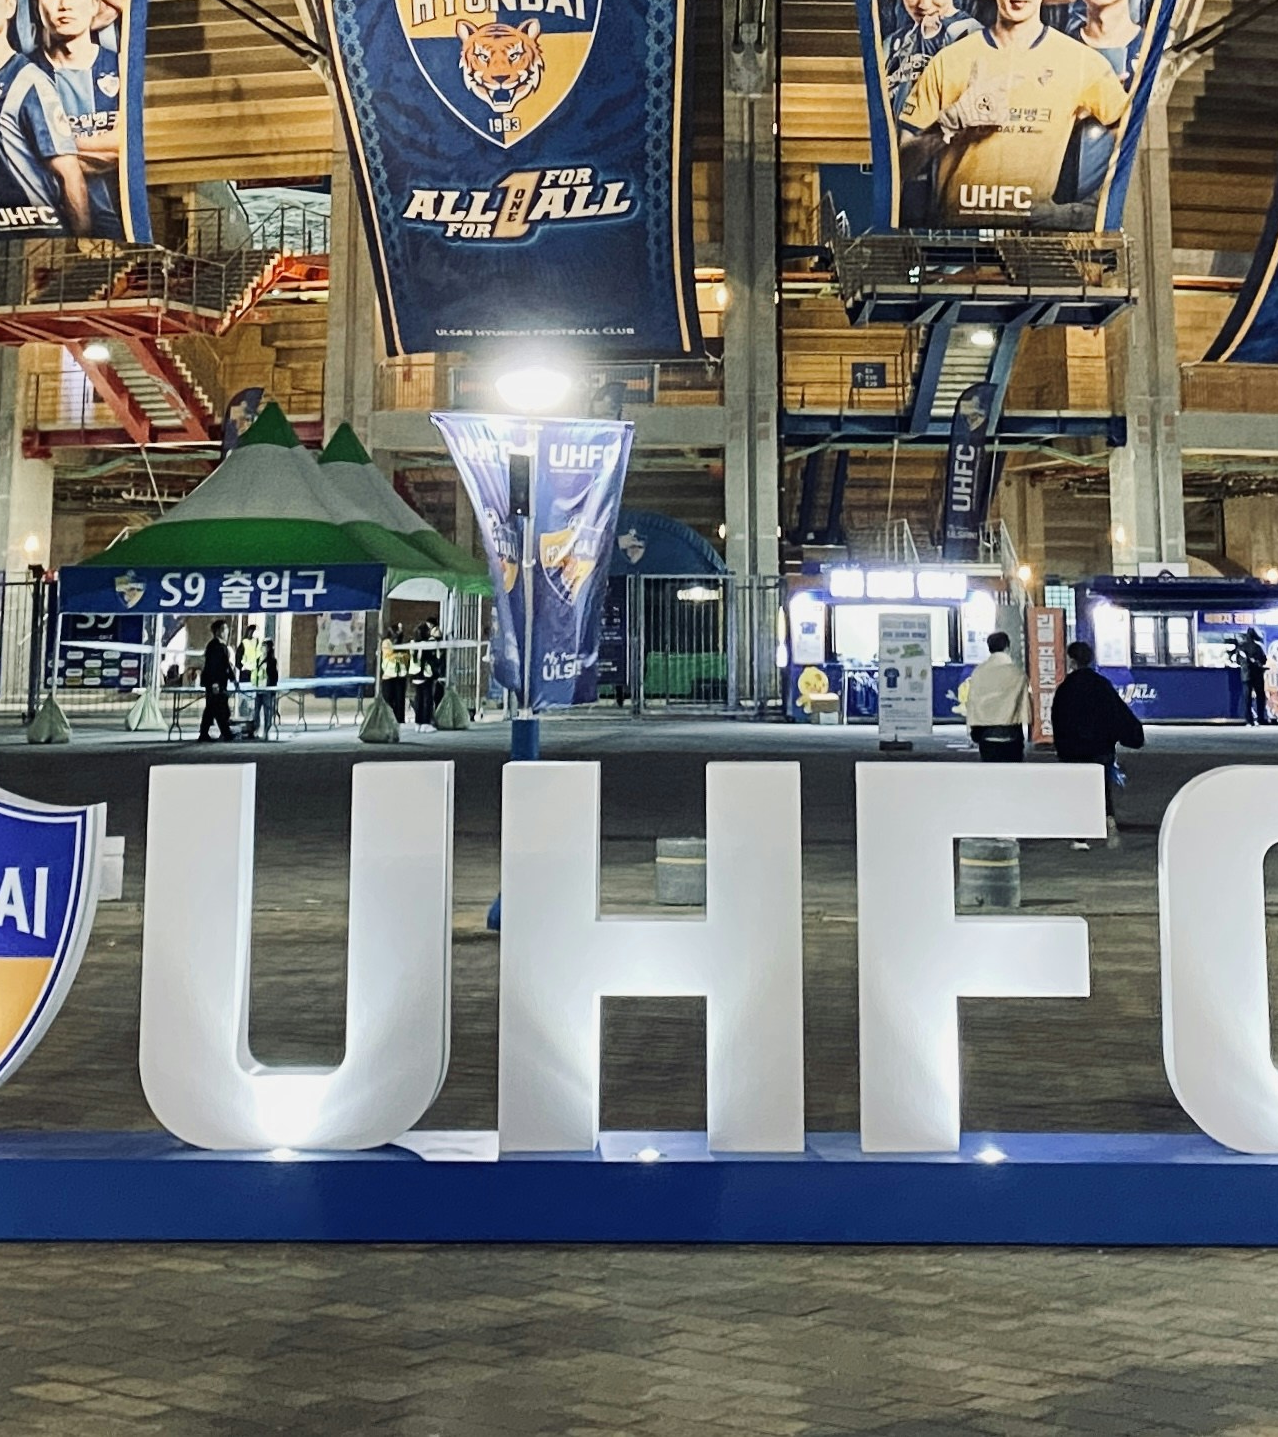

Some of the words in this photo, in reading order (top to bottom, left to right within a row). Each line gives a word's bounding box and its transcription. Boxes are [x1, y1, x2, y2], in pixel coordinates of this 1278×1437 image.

[488, 117, 522, 133] 1983
[541, 167, 593, 187] FOR
[403, 189, 498, 223] ALL
[528, 181, 632, 221] ALL
[959, 183, 1033, 209] UHFC
[445, 222, 493, 239] FOR
[435, 328, 473, 337] ULSAN
[601, 327, 636, 336] CLUB
[951, 444, 976, 512] UHFC
[160, 572, 206, 608] S9
[219, 569, 328, 610] 출입구
